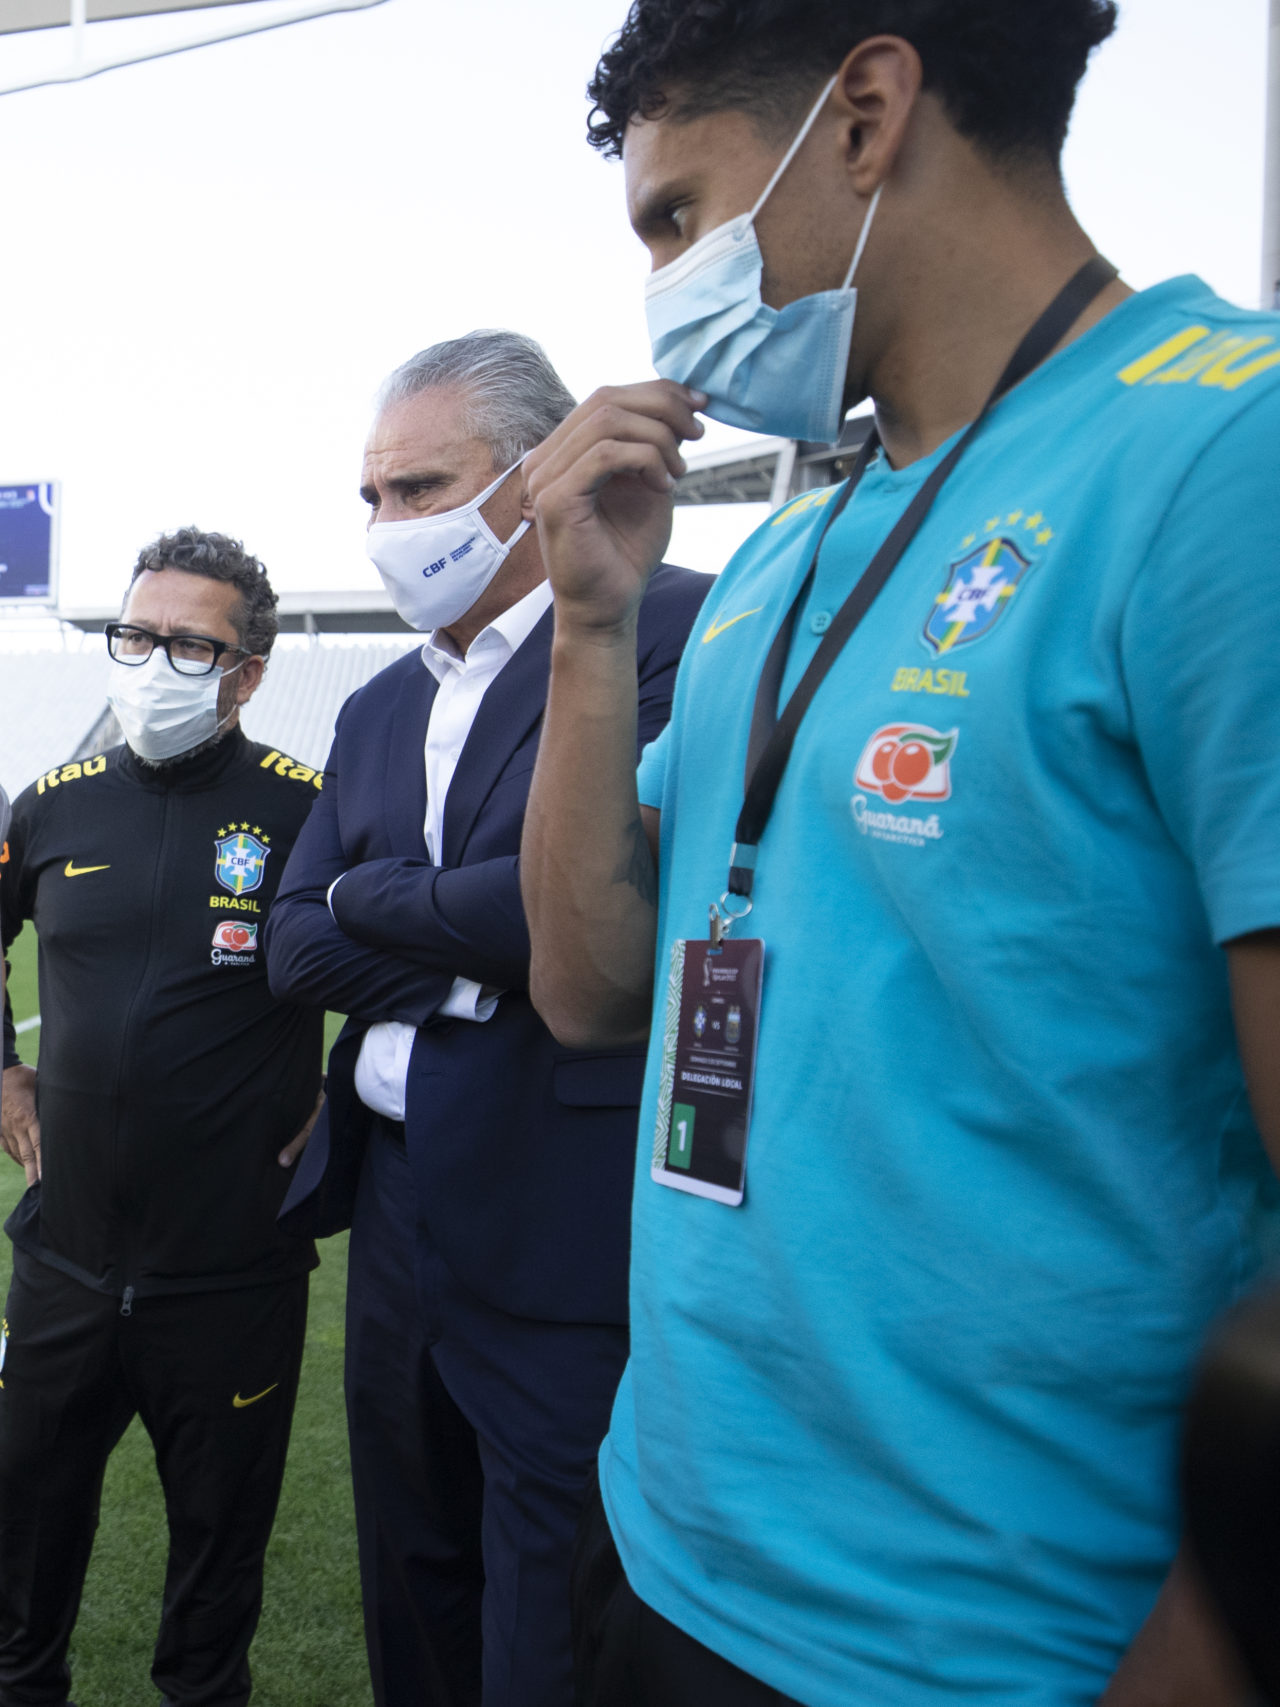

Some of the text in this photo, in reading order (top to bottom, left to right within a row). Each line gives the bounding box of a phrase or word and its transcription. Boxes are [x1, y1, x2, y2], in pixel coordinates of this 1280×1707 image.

[422, 557, 447, 578] CBF
[891, 667, 969, 697] BRASIL
[37, 754, 107, 796] Itaú
[231, 857, 250, 866] CBF
[209, 896, 261, 912] BRASIL
[681, 1070, 743, 1091] DELEGACIÓN LOCAL
[677, 1120, 688, 1152] 1
